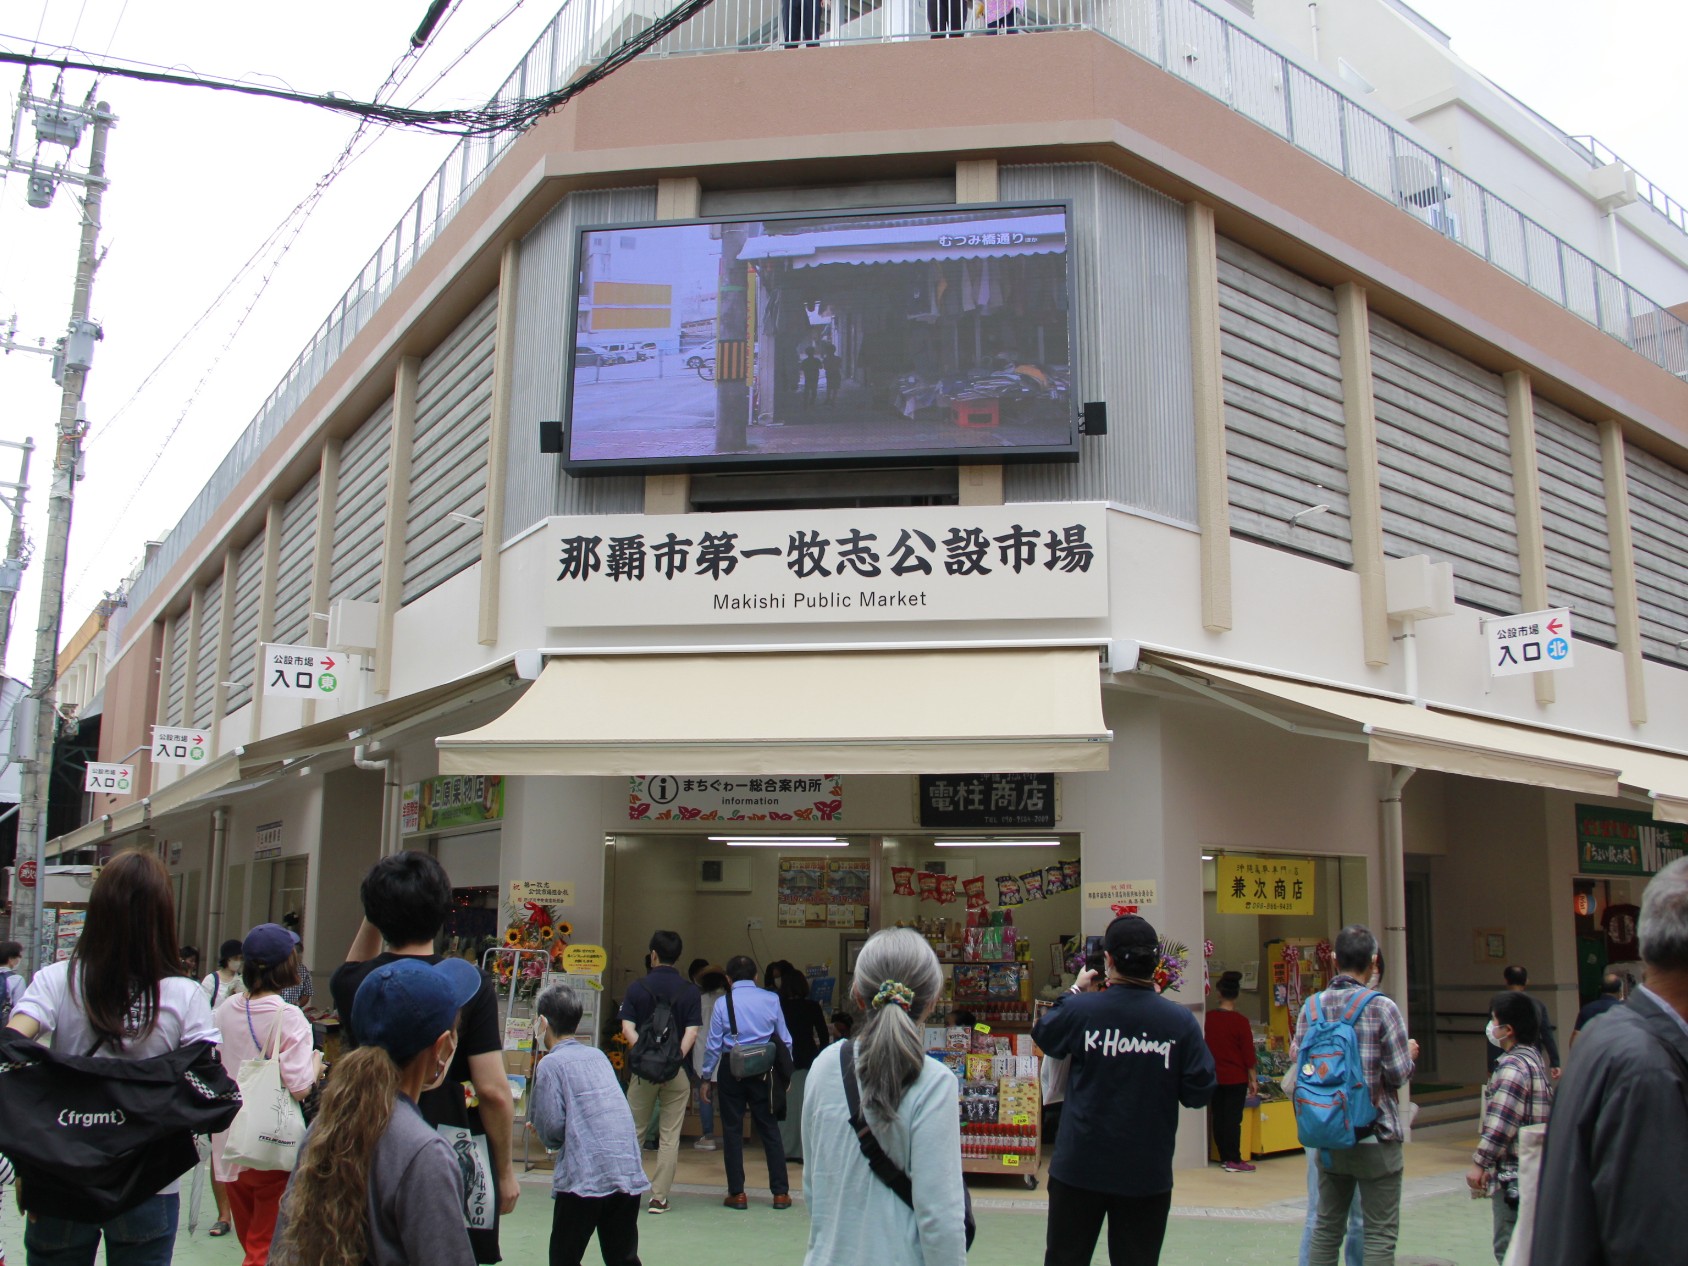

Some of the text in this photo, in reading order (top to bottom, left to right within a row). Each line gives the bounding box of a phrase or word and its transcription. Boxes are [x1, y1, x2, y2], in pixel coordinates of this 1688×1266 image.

[939, 233, 1024, 247] むつみ橋通り
[557, 524, 1094, 583] 那覇市第一牧志公設市場
[714, 591, 927, 610] Makishi Public Market
[1497, 624, 1539, 639] 公設市場
[273, 655, 314, 667] 公設市場
[1498, 642, 1541, 666] 入口
[271, 669, 313, 688] 入口
[159, 733, 188, 743] 公設市場
[156, 745, 187, 758] 入口
[90, 777, 115, 788] 入口
[721, 797, 779, 805] information
[929, 779, 1047, 812] 電柱商店
[1231, 876, 1304, 900] 兼次商店
